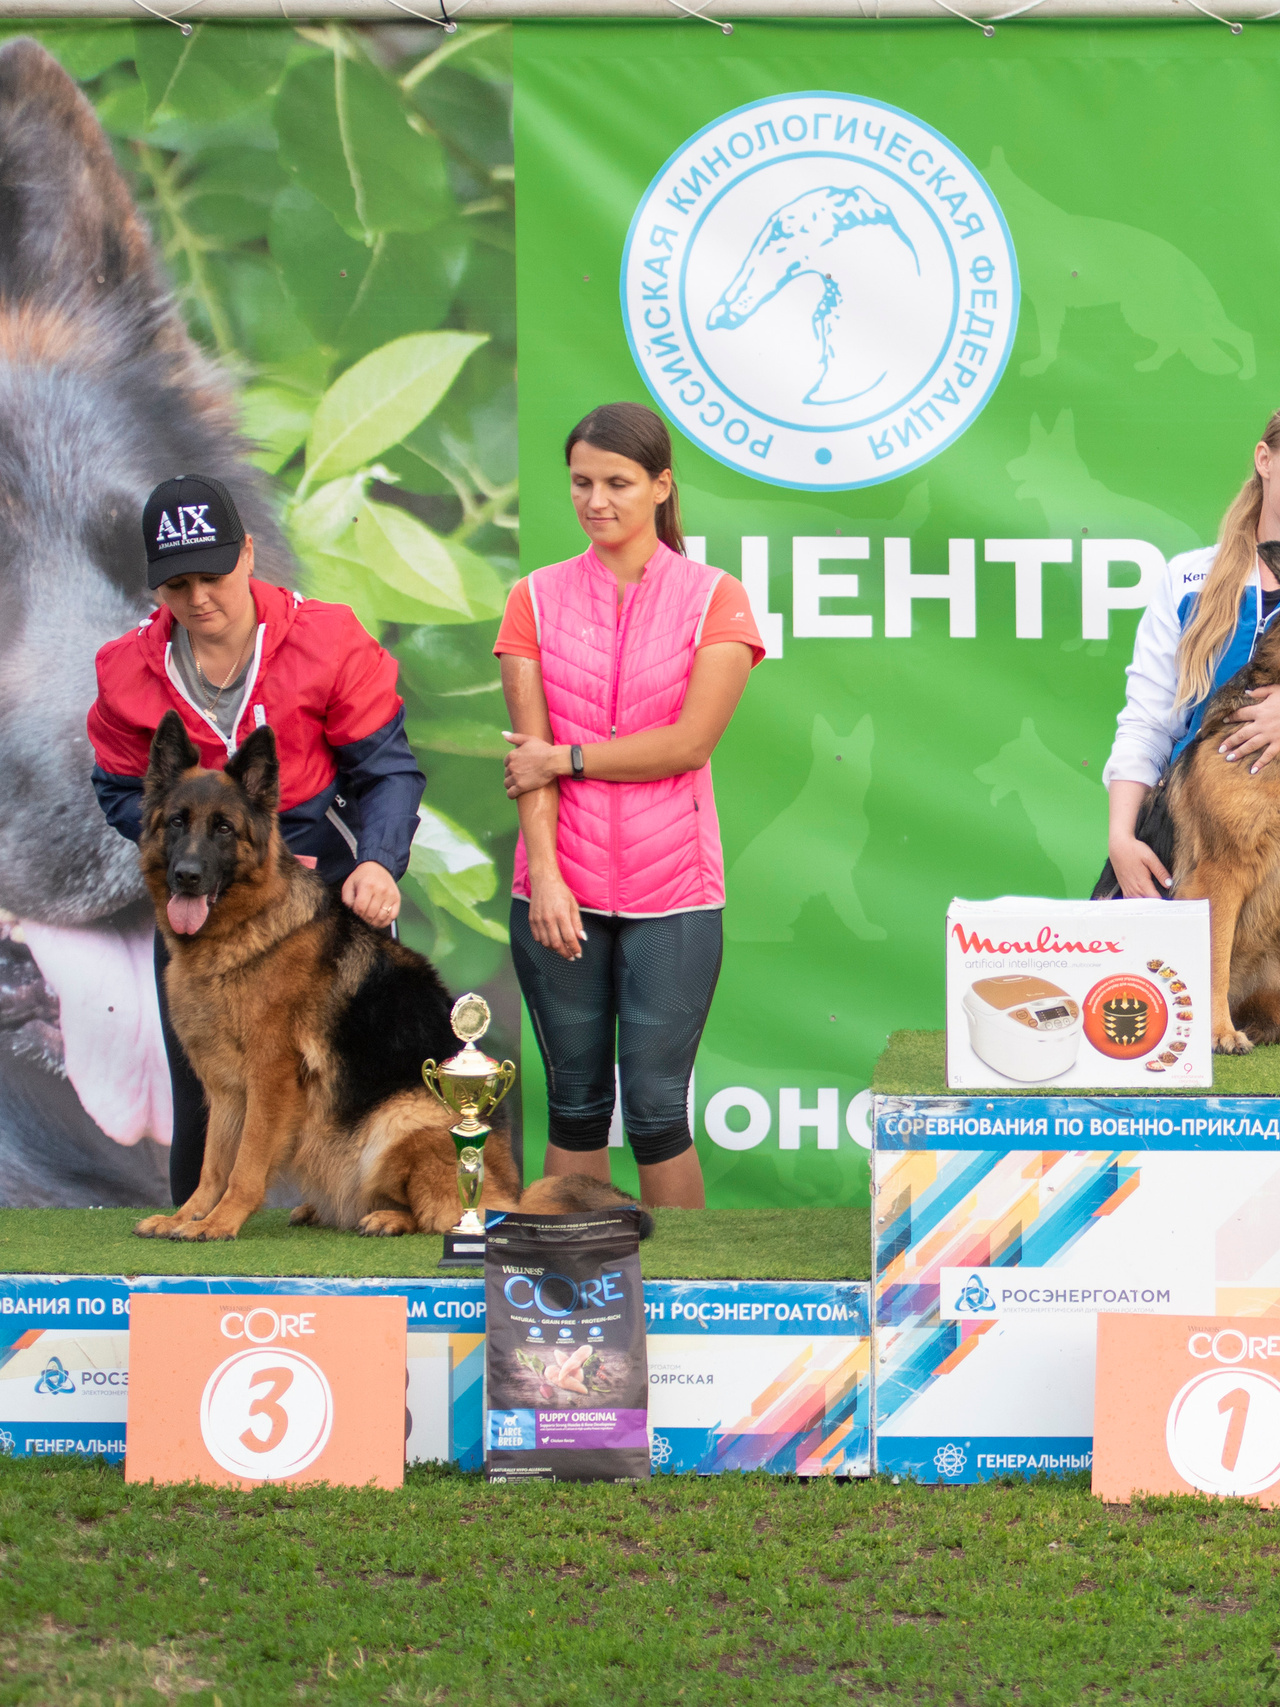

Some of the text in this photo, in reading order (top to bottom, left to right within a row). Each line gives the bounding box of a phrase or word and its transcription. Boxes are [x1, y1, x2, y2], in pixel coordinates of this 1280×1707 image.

[641, 113, 998, 461] РОССИЙСКАЯ КИНОЛОГИЧЕСКАЯ ФЕДЕРАЦИЯ
[952, 923, 1124, 954] Moulinex
[965, 959, 1068, 971] artificial intelligence
[885, 1118, 1048, 1136] СОРЕВНОВАНИЯ
[1055, 1118, 1084, 1136] ПО
[502, 1265, 543, 1275] WELLNESS
[504, 1271, 624, 1317] CORE
[1002, 1289, 1170, 1303] РОСЭНЕРГОАТОМ
[77, 1298, 105, 1315] ПО
[220, 1308, 316, 1343] CORE
[511, 1314, 536, 1324] NATURAL
[581, 1314, 621, 1325] PROTEIN-RICH
[238, 1366, 294, 1453] 3
[539, 1412, 617, 1422] PUPPY ORIGINAL
[498, 1427, 522, 1437] LARGE
[1218, 1387, 1250, 1473] 1
[498, 1437, 523, 1447] BREED
